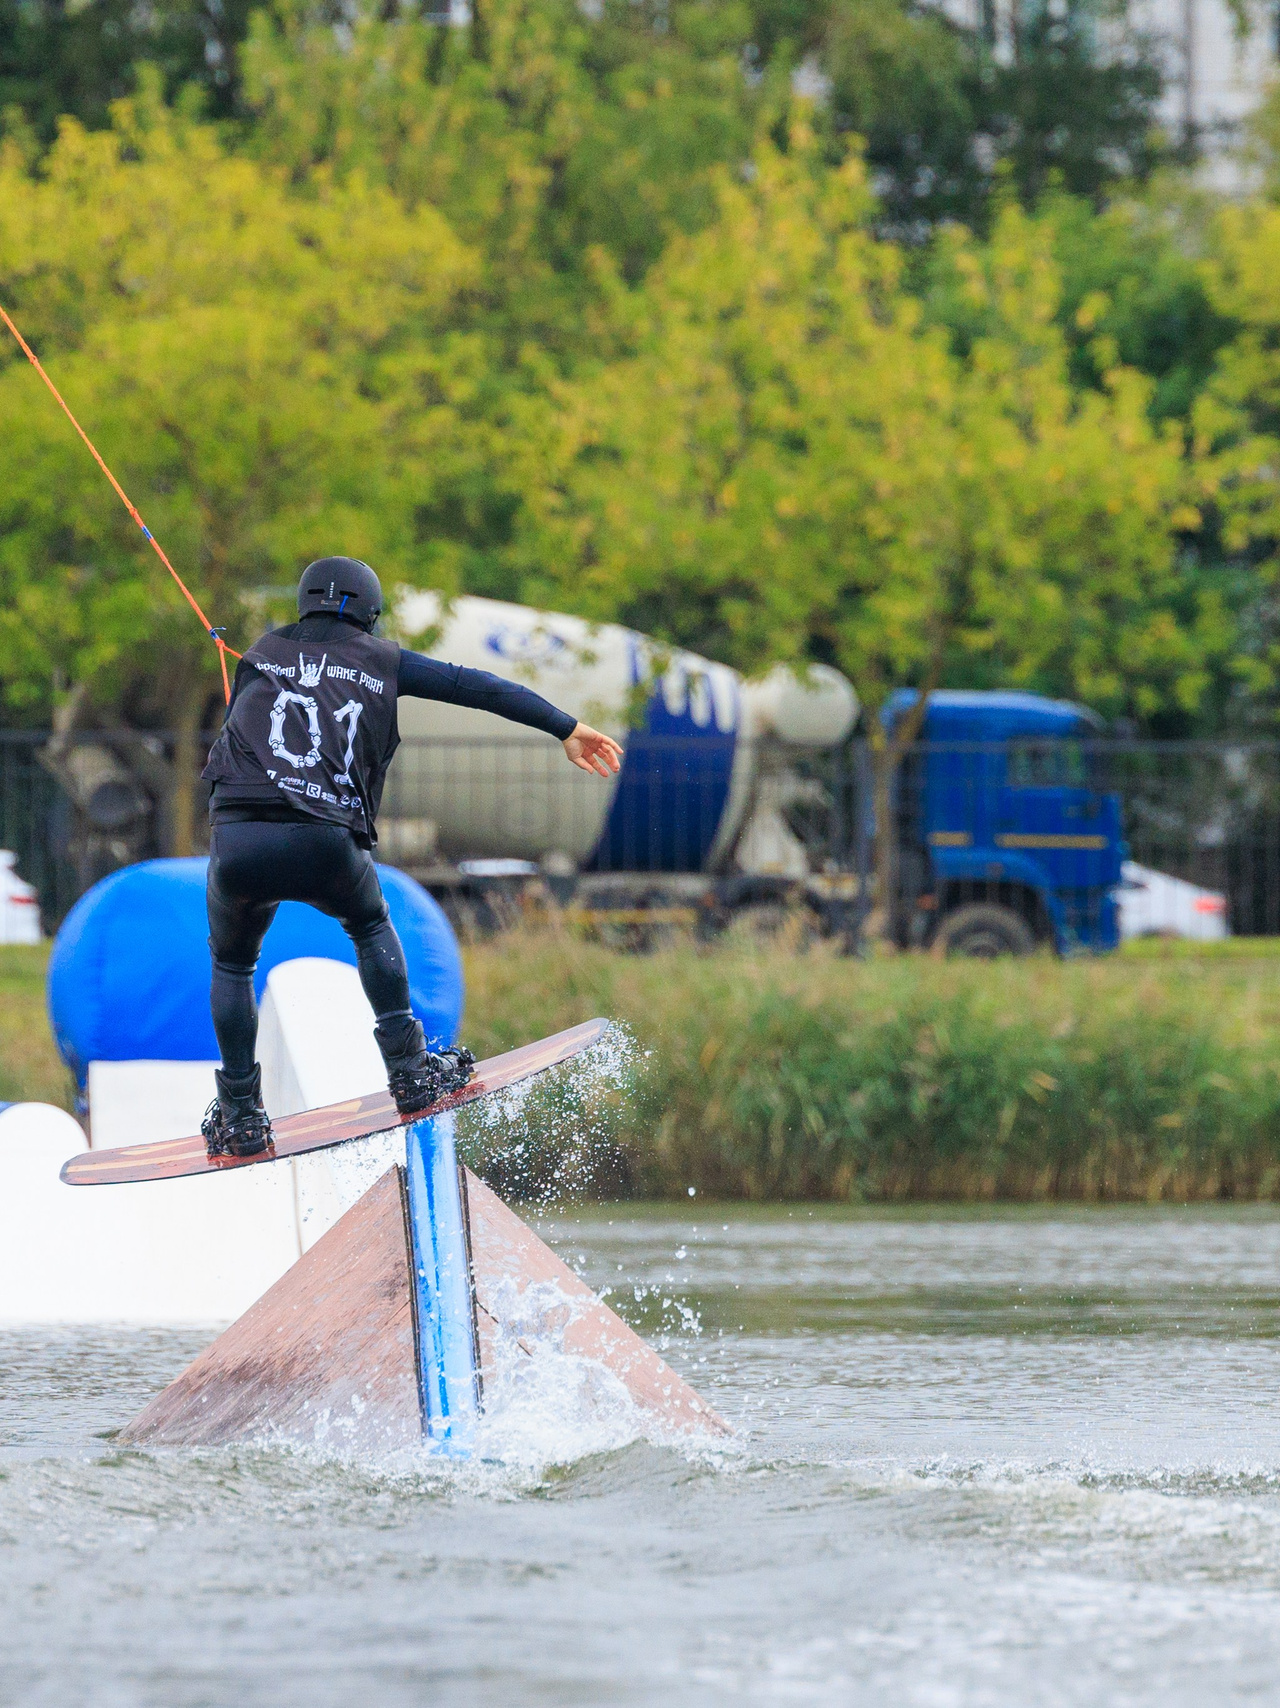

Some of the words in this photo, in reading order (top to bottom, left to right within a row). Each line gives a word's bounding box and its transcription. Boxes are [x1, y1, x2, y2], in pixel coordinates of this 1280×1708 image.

[326, 665, 358, 683] WAKE
[359, 671, 385, 695] PARK
[268, 688, 364, 788] 01
